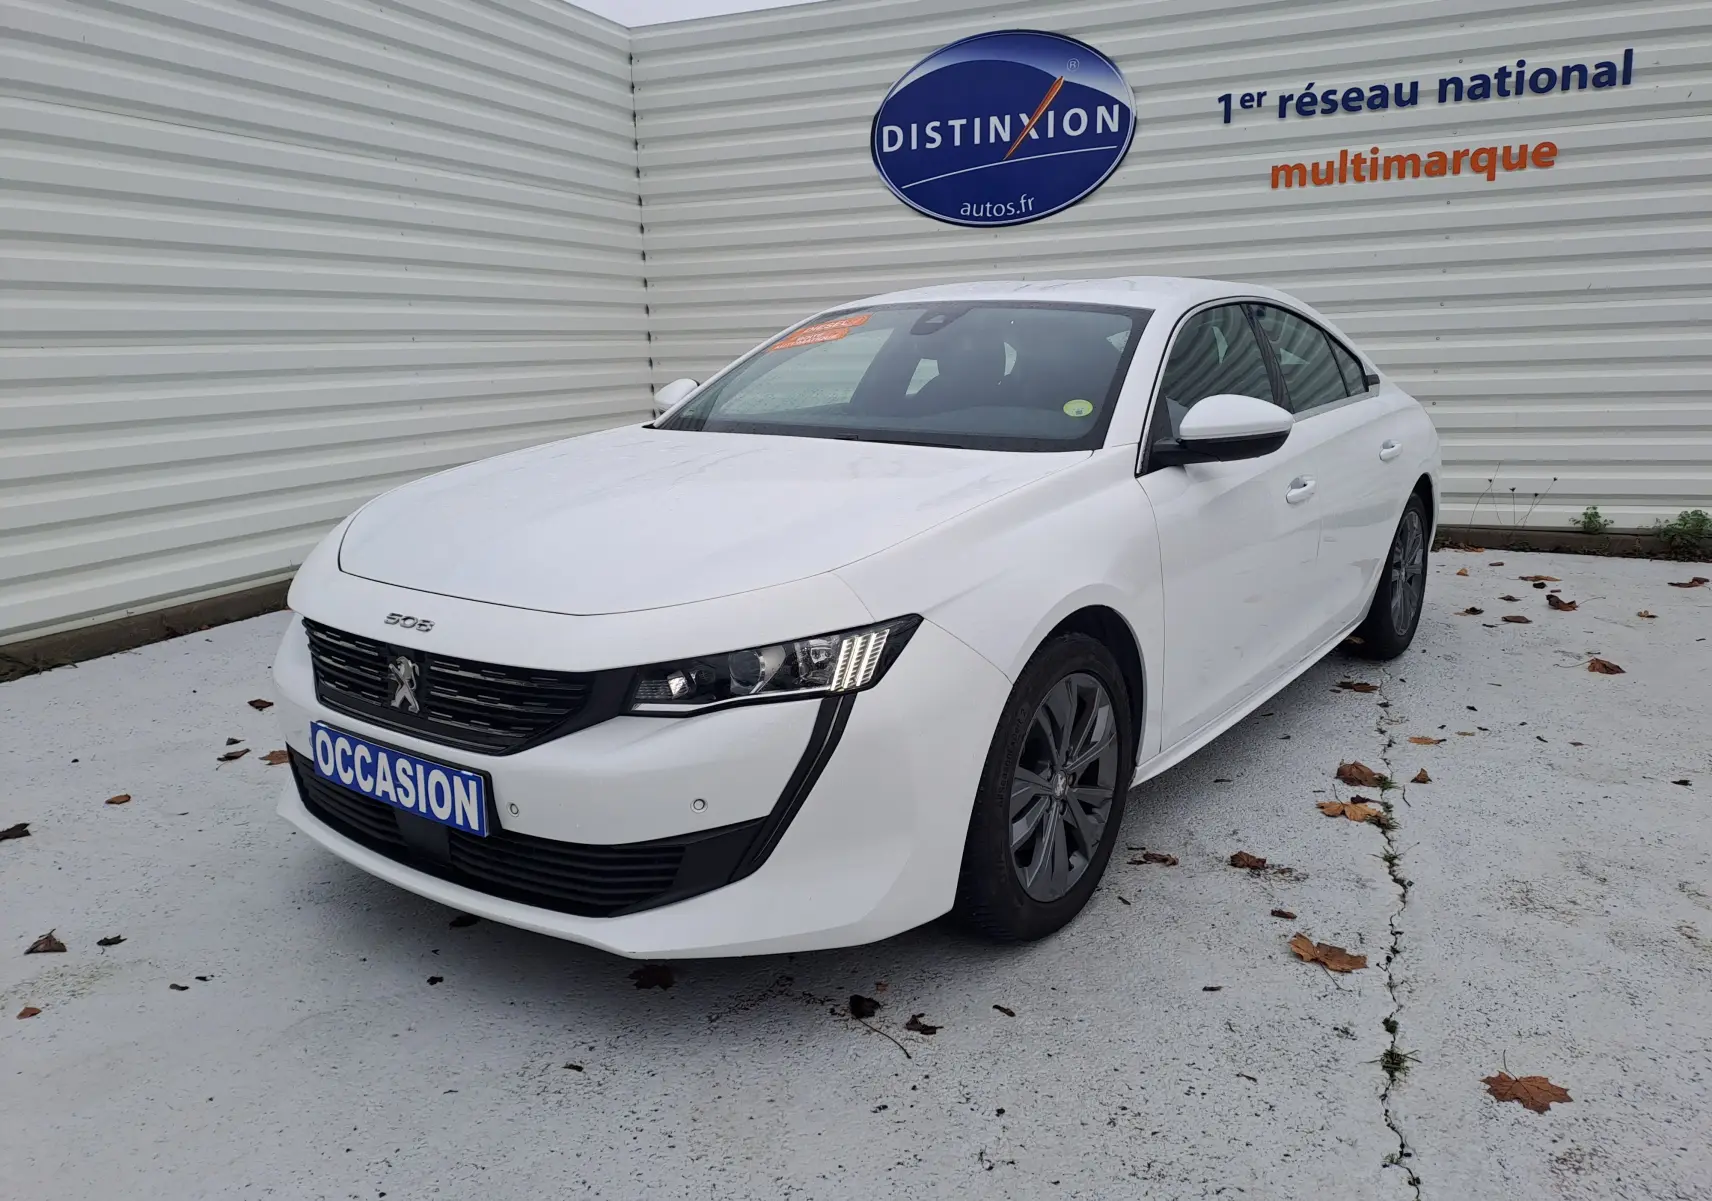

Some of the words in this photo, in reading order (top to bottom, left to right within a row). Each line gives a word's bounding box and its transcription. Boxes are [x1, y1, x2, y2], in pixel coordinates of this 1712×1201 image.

[1278, 80, 1419, 119] réseau
[1437, 49, 1634, 104] national
[882, 104, 1119, 153] DISTINXION
[1270, 140, 1557, 189] multimarque
[960, 194, 1035, 217] autos.fr
[384, 613, 435, 632] 508
[315, 729, 480, 831] OCCASION
